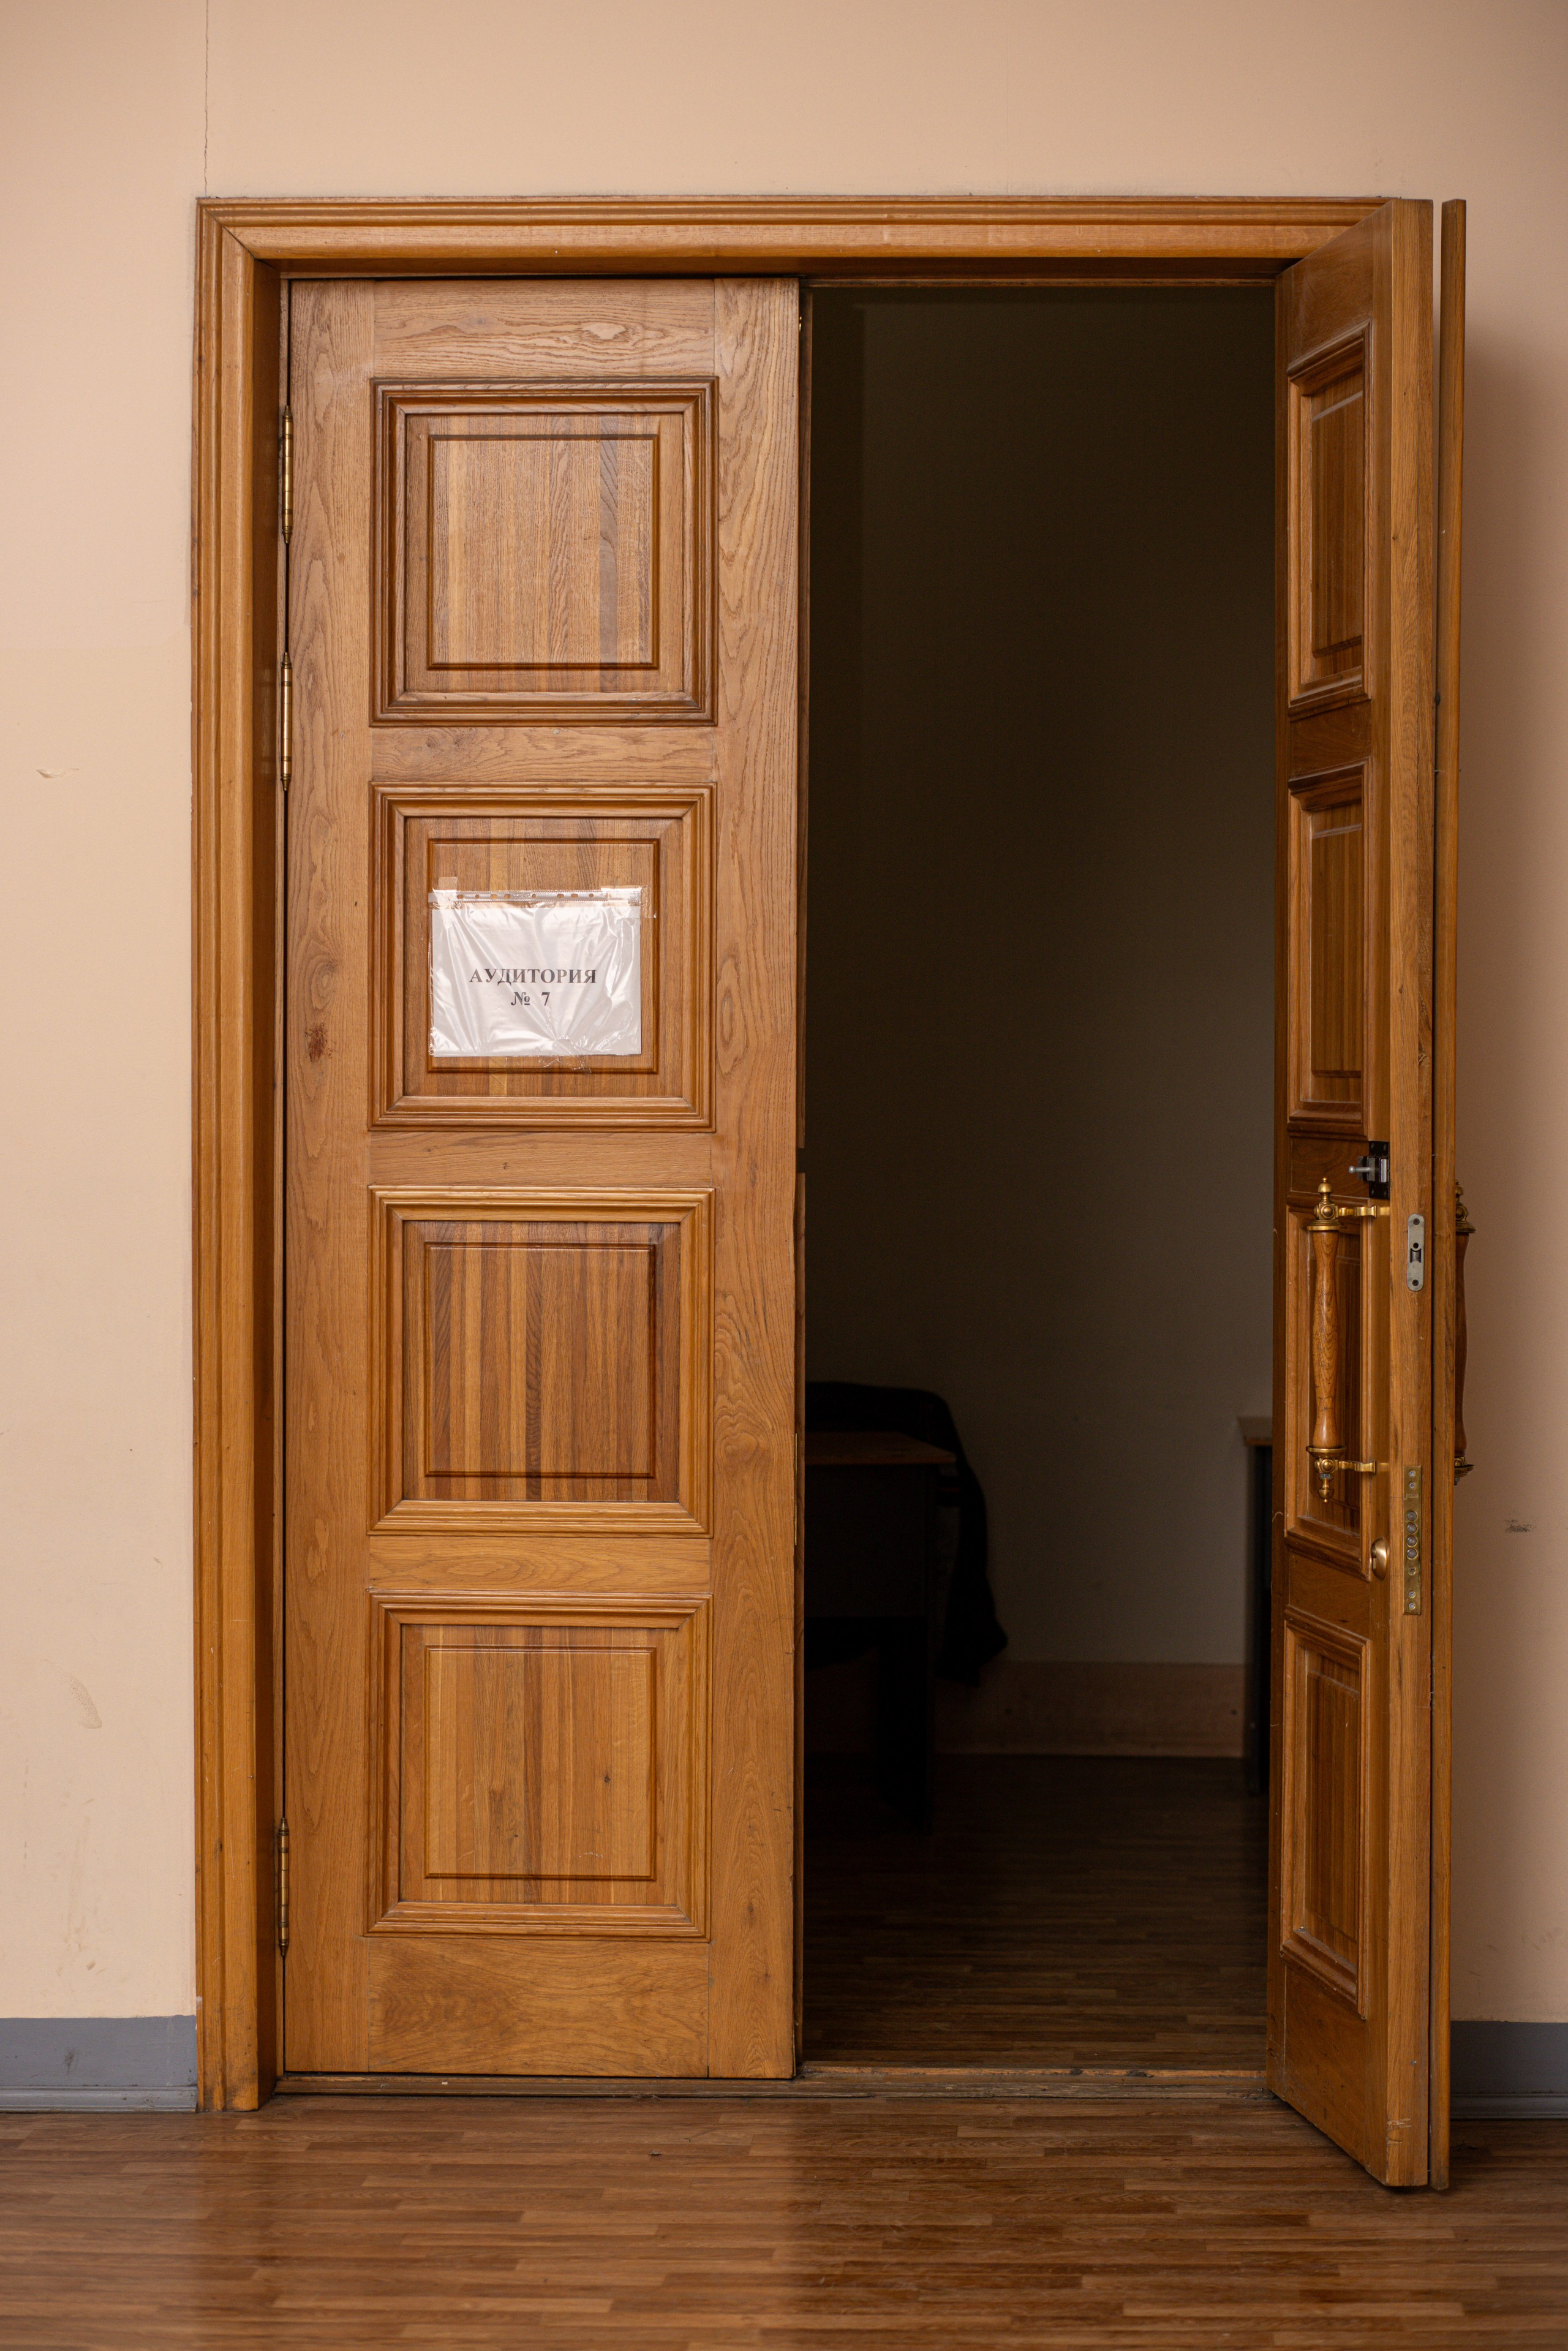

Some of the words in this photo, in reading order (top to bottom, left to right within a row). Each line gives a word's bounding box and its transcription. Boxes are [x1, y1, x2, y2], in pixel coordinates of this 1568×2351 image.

[469, 968, 597, 986] АУДИТОРИЯ
[510, 992, 530, 1006] №
[541, 992, 550, 1006] 7
